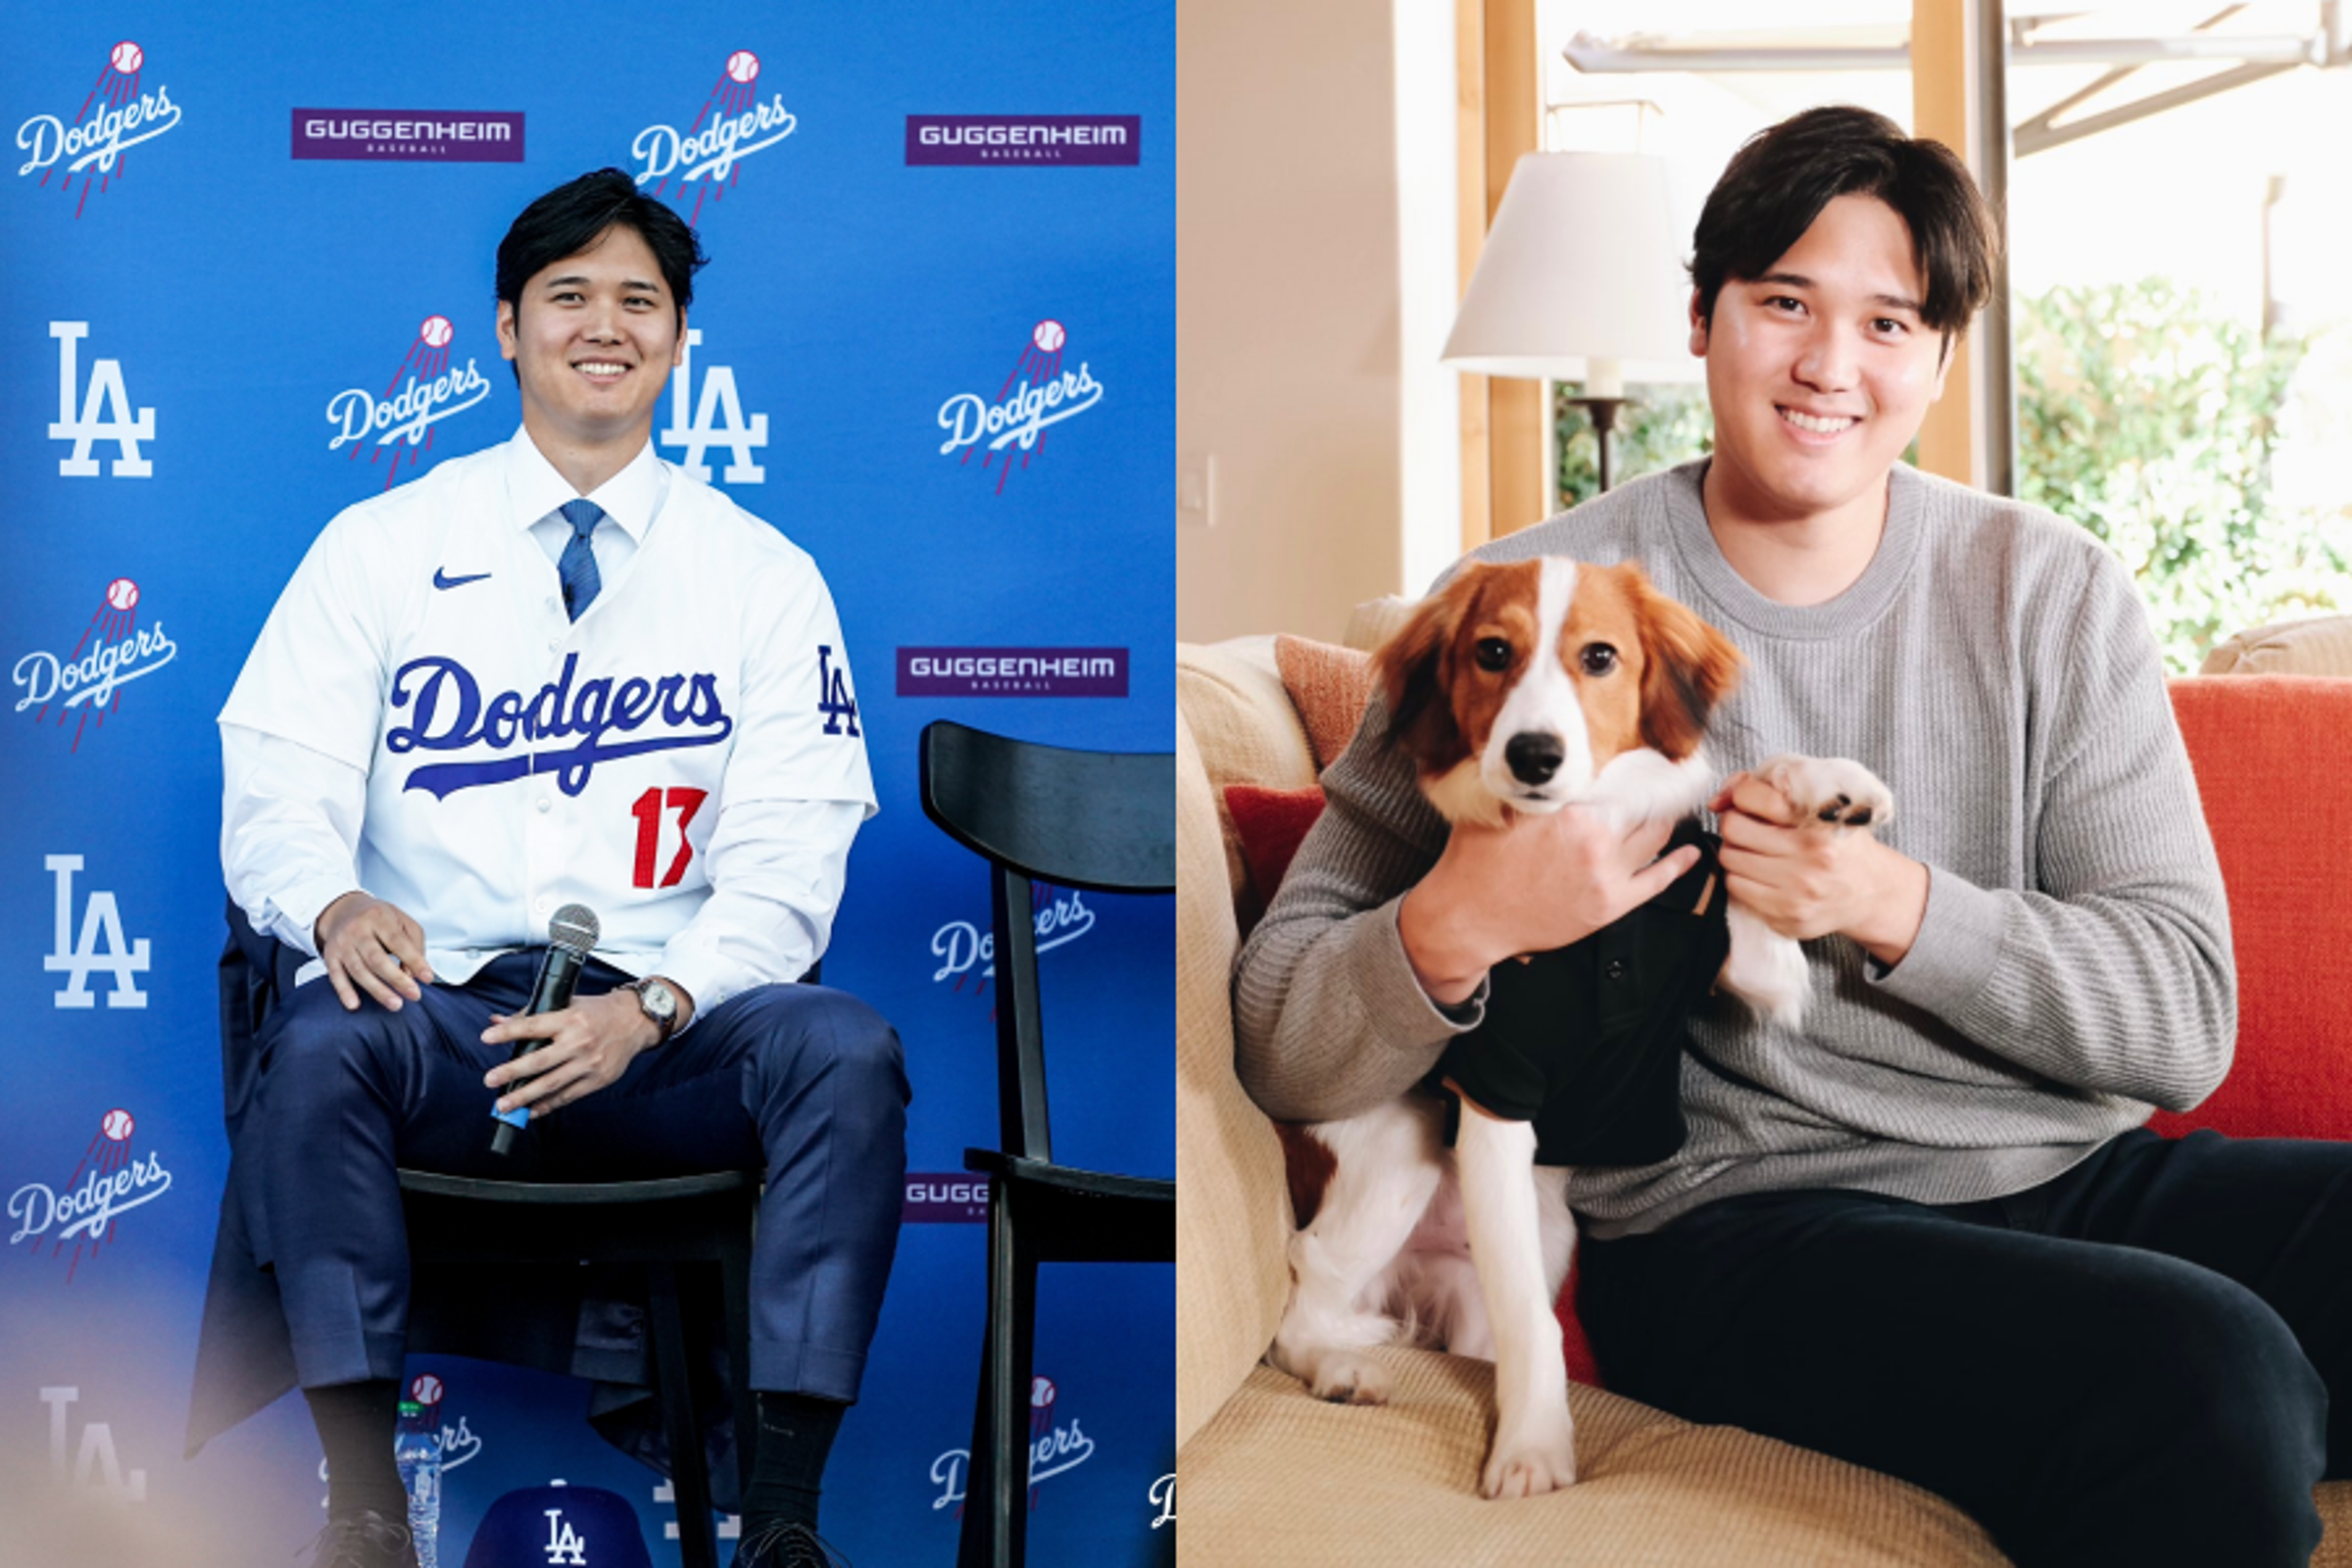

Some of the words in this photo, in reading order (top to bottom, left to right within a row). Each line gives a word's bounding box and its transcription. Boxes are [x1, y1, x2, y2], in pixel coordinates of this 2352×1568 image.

[17, 85, 181, 176] Dodgers
[305, 119, 512, 141] GUGGENHEIM
[632, 93, 797, 186] Dodgers
[919, 125, 1127, 145] GUGGENHEIM
[49, 320, 156, 477] LA
[325, 359, 491, 451] Dodgers
[661, 328, 768, 484] LA
[938, 363, 1103, 455] Dodgers
[13, 621, 177, 712] Dodgers
[817, 645, 860, 738] LA
[910, 657, 1115, 677] GUGGENHEIM
[386, 652, 733, 803] Dodgers
[631, 786, 710, 890] 13
[44, 855, 151, 1008] LA
[930, 890, 1096, 982] Doers
[7, 1151, 172, 1245] Dodgers
[544, 1509, 587, 1565] LA
